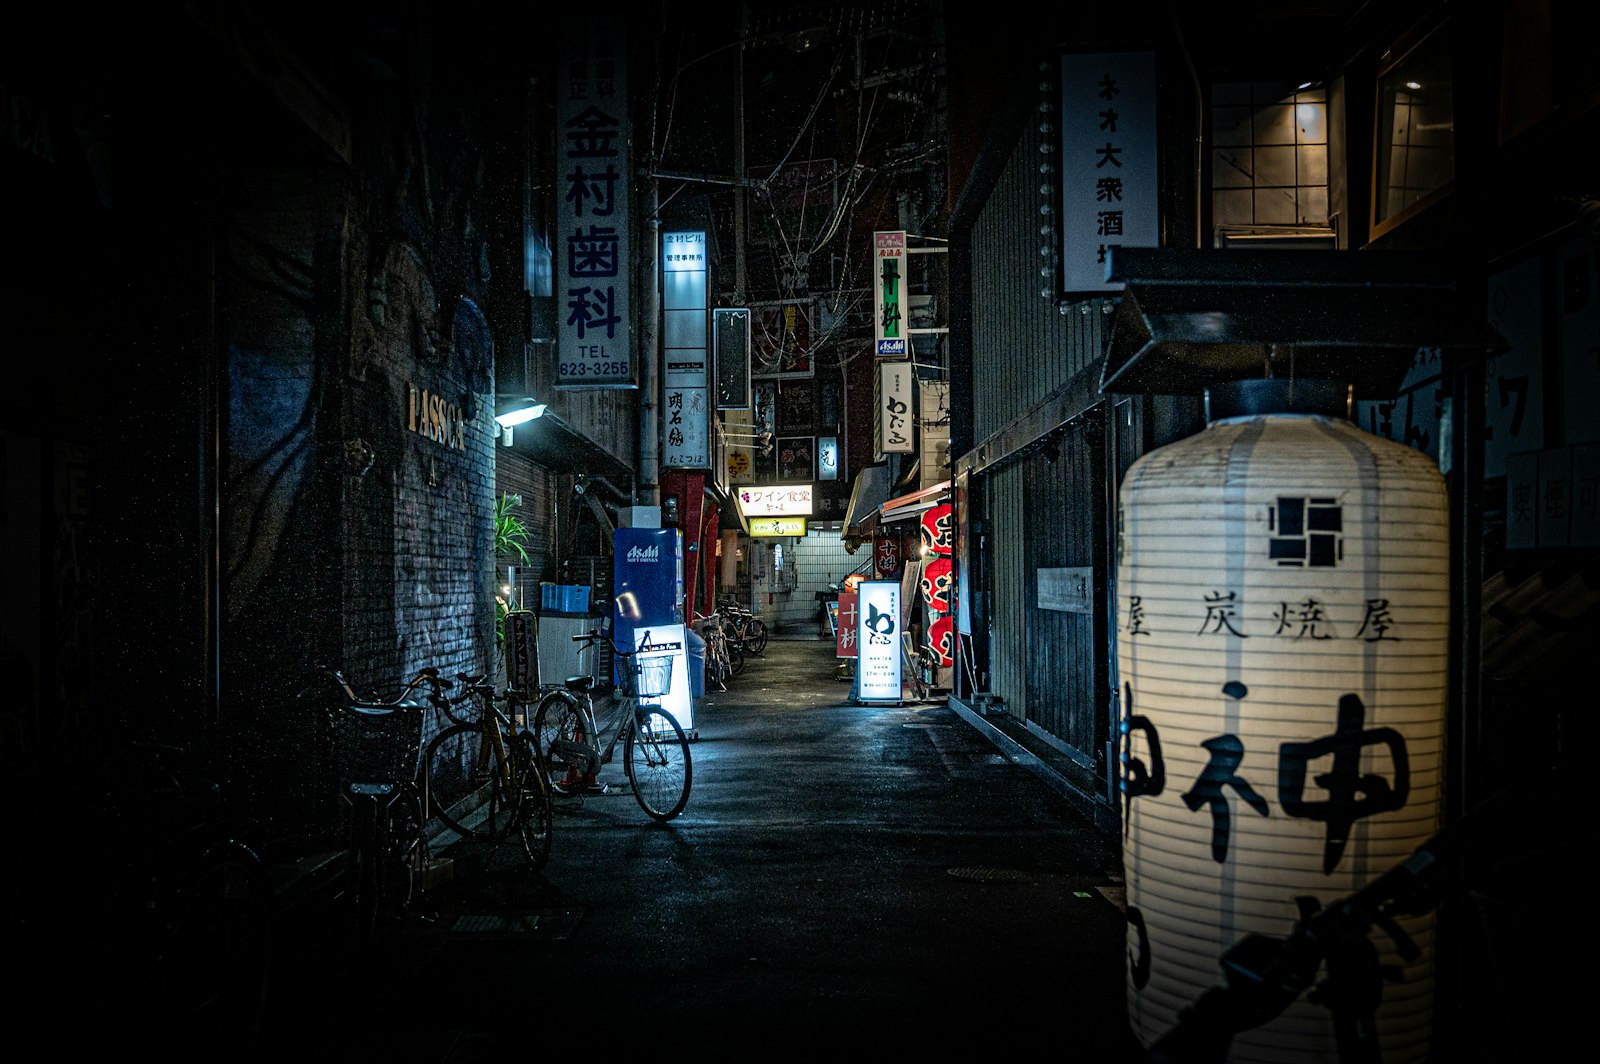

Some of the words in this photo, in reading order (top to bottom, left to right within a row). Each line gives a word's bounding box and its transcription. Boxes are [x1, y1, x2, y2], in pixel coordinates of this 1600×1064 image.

[566, 105, 621, 338] 金村歯科
[667, 234, 703, 243] 金村ビル
[666, 253, 703, 262] 管理事務所
[878, 249, 902, 257] 居酒屋
[578, 345, 611, 358] TEL
[880, 340, 904, 351] Asahi
[559, 362, 628, 376] 623-3255
[886, 396, 908, 445] わたる
[753, 490, 811, 502] ワイン食堂
[627, 545, 659, 558] Asahi
[1197, 589, 1401, 643] 炭焼屋
